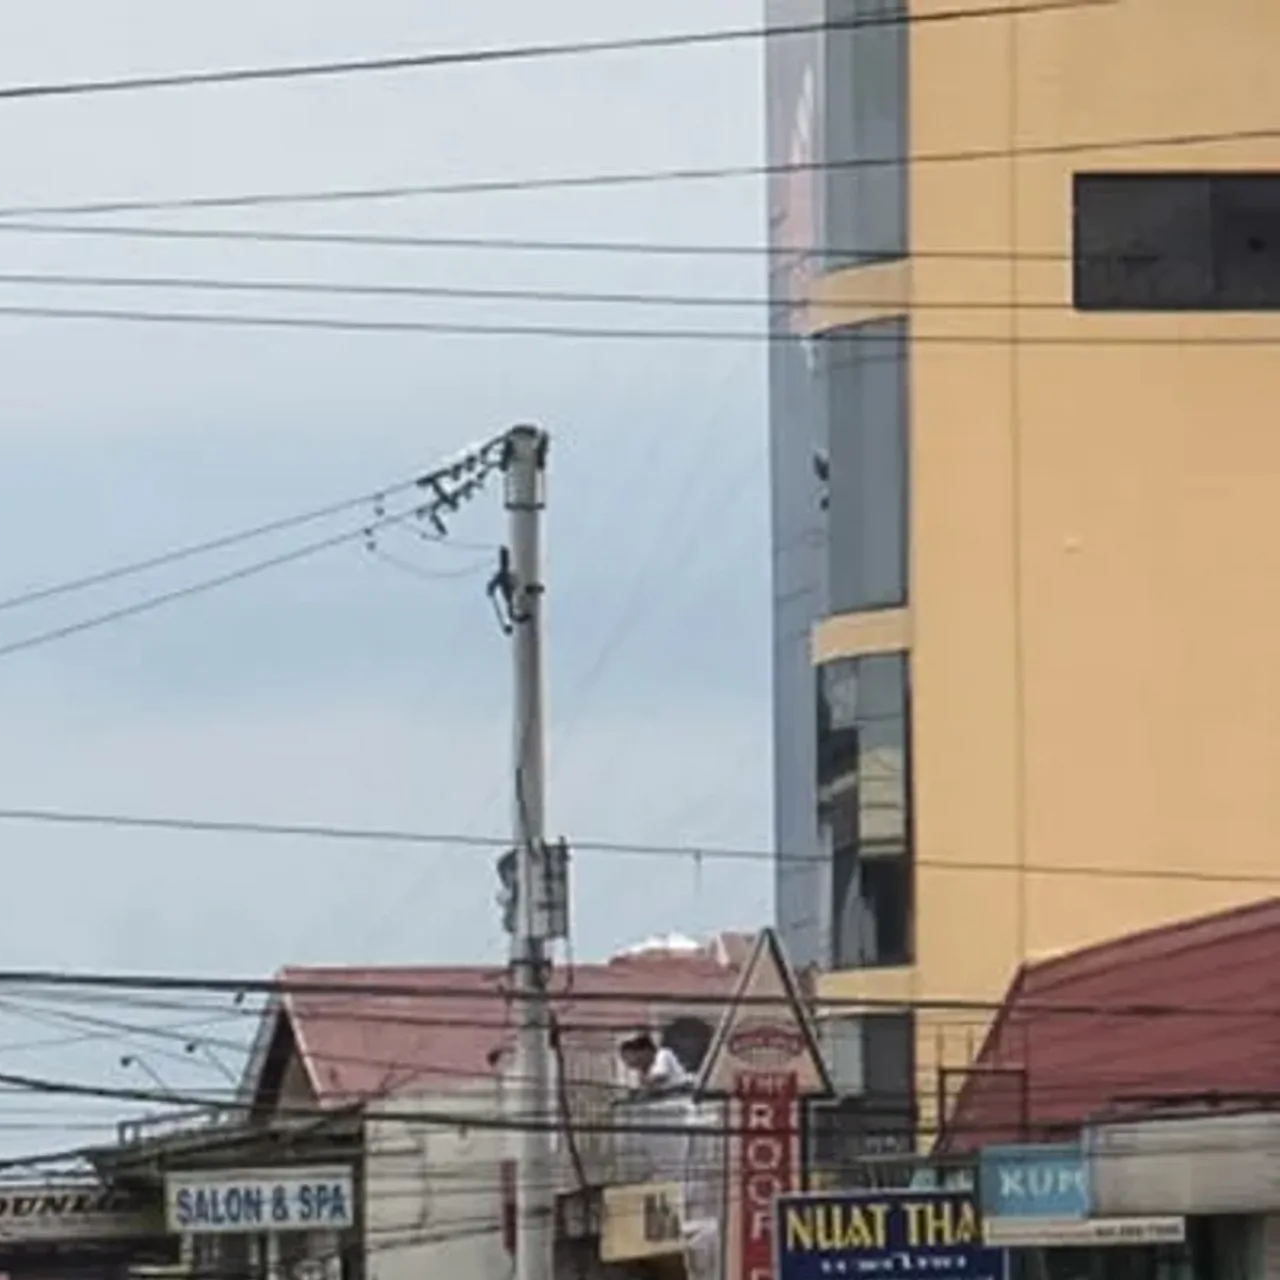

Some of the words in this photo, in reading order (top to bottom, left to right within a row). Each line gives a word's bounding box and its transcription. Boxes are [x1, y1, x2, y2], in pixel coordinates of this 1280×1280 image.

[176, 1186, 262, 1227] SALON
[271, 1186, 290, 1223] &
[298, 1183, 348, 1221] SPA
[786, 1203, 889, 1251] NUAT
[905, 1201, 987, 1246] THA
